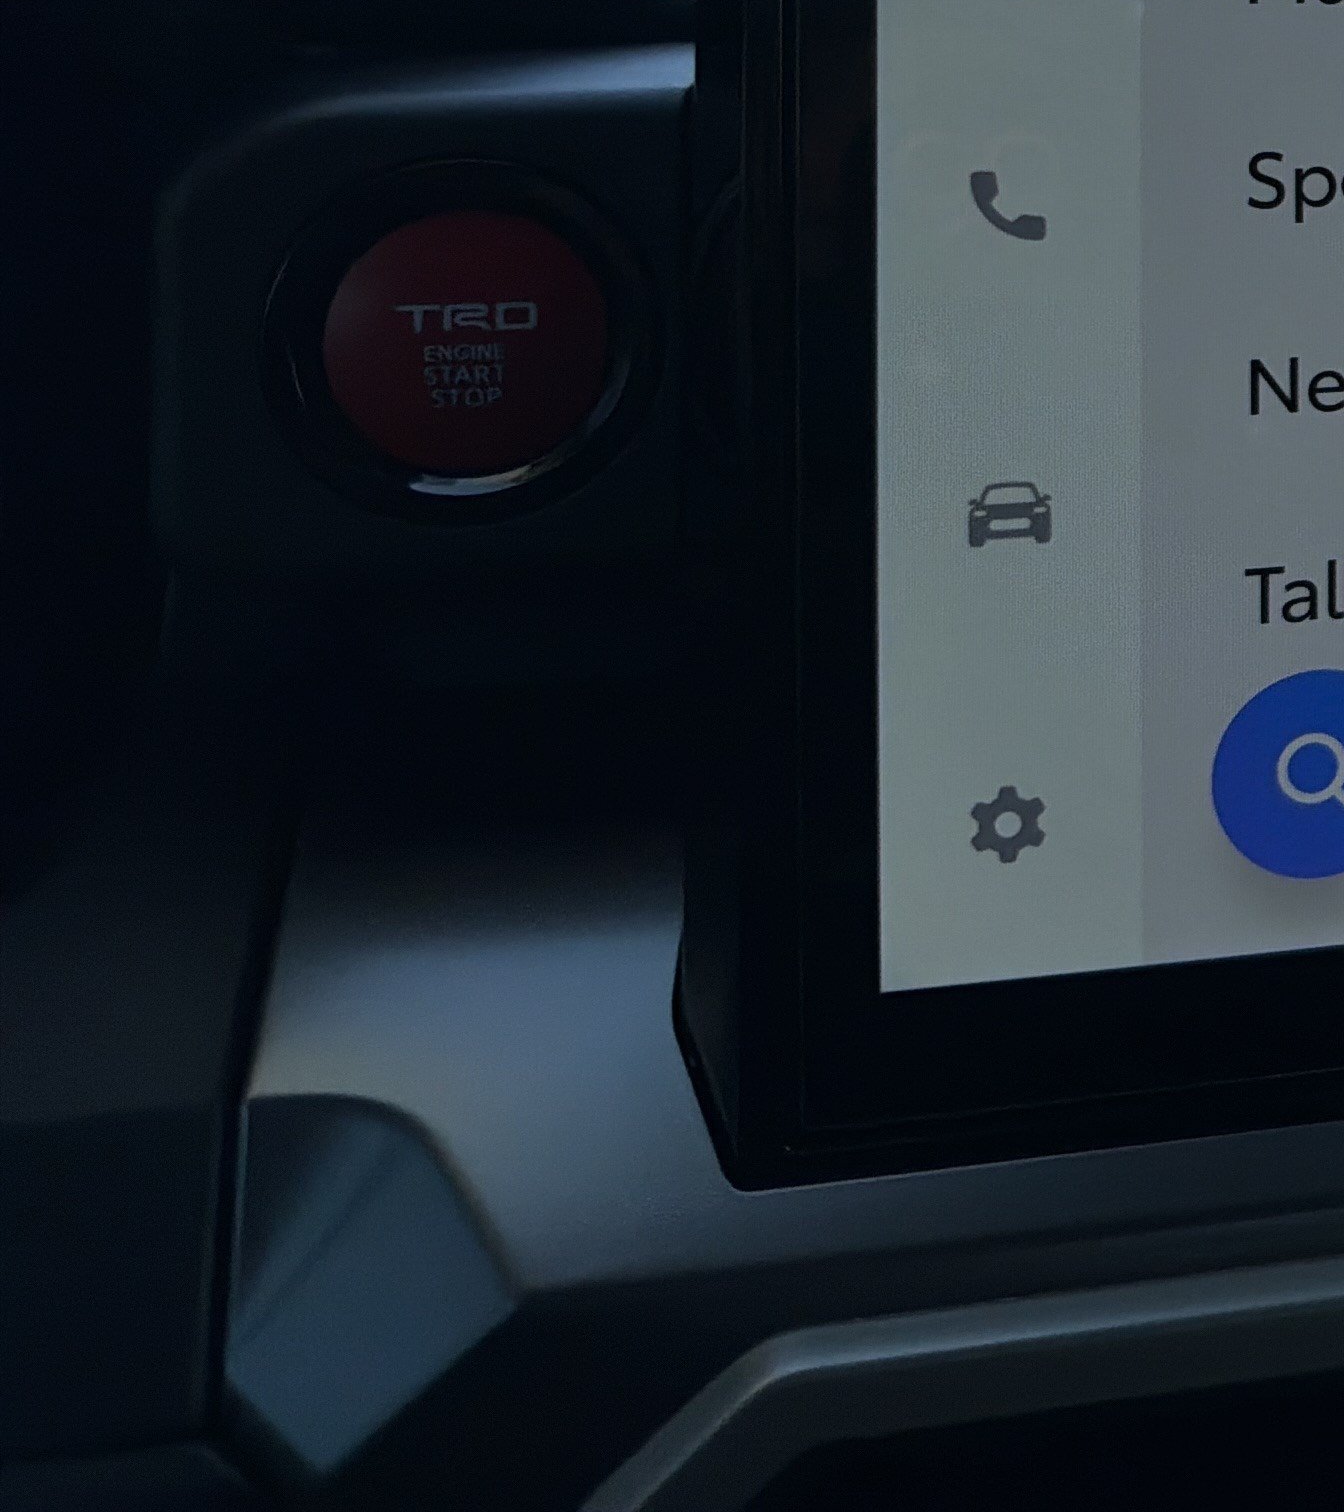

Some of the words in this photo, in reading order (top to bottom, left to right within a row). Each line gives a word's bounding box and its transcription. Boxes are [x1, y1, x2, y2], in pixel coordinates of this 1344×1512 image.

[394, 300, 540, 335] TRD
[422, 343, 506, 363] ENGINE
[422, 364, 505, 386] START
[431, 387, 503, 409] STOP
